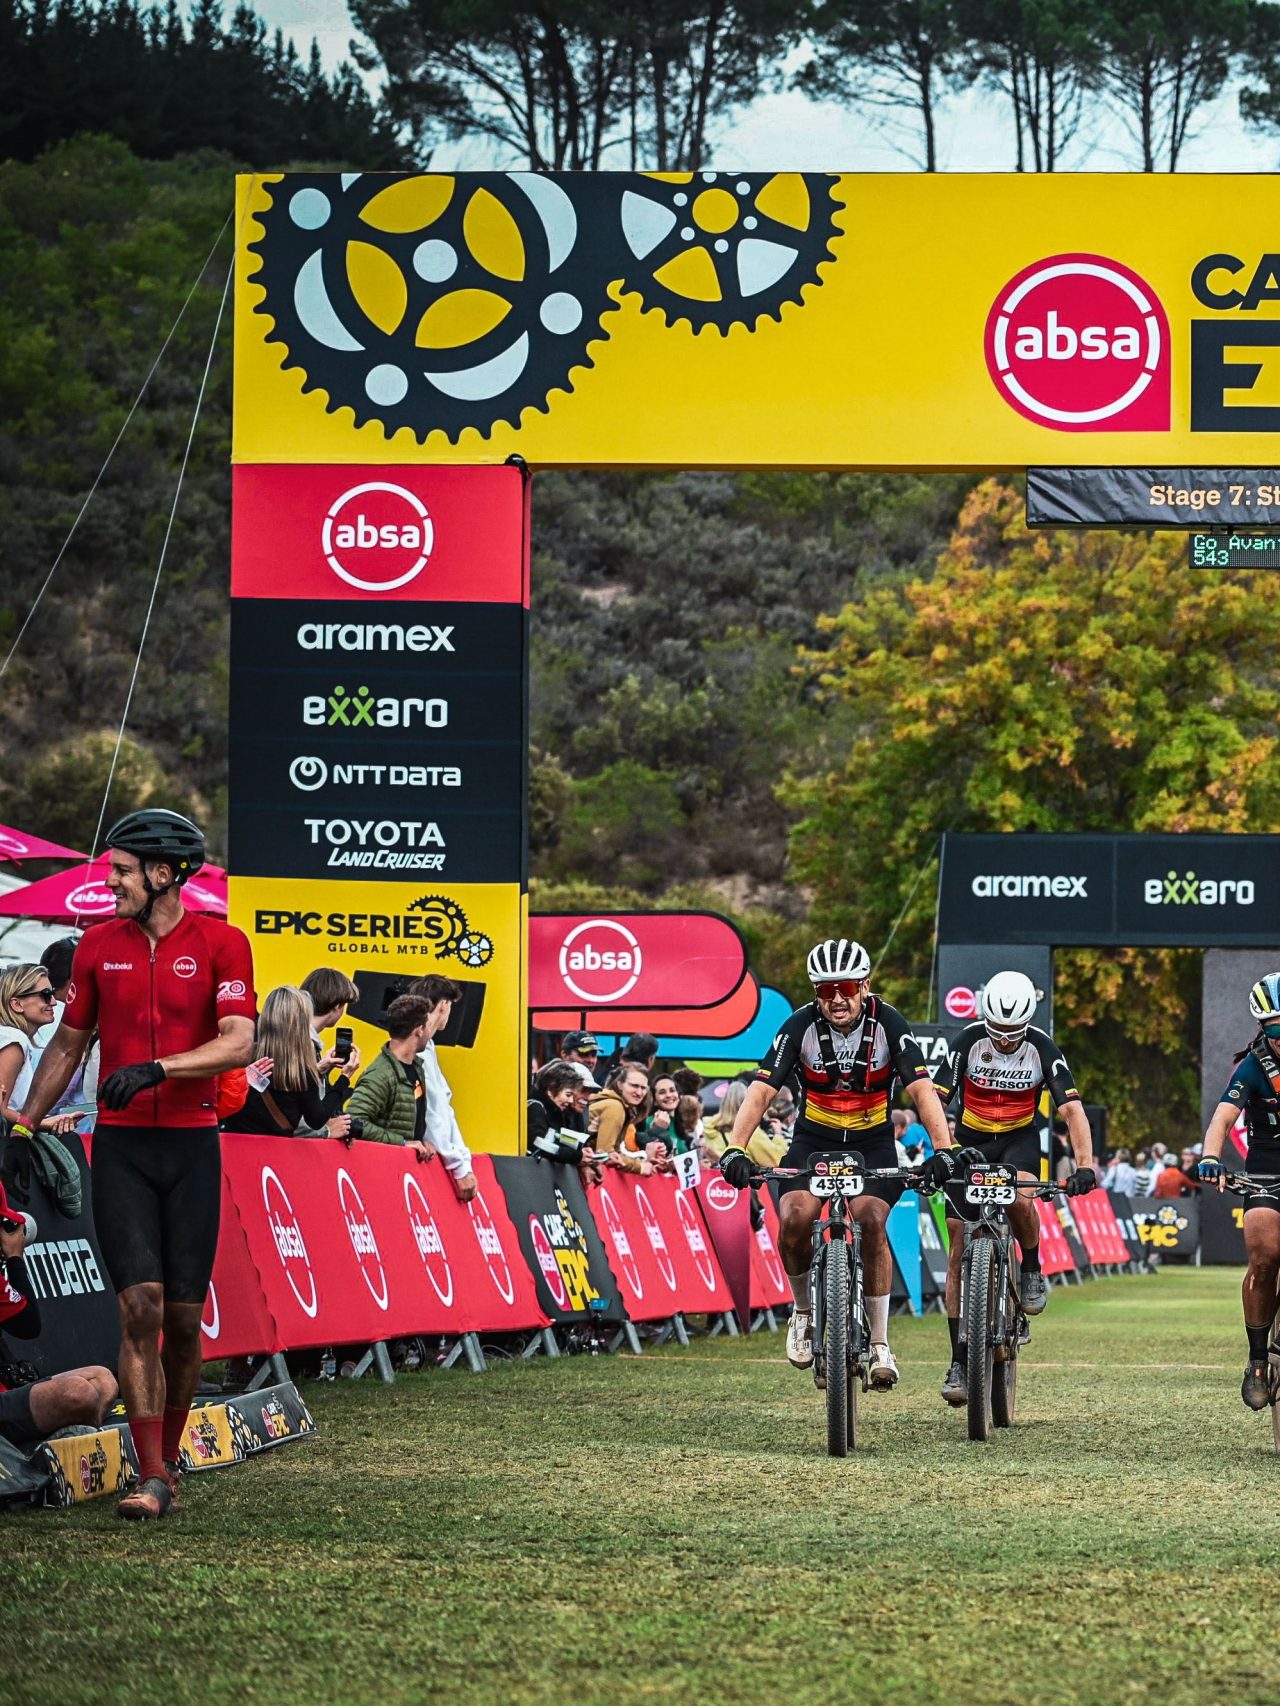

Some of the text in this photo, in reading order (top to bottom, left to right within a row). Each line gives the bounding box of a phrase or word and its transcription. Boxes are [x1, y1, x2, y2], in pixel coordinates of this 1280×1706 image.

[1015, 311, 1139, 360] absa
[1149, 485, 1221, 510] Stage
[1229, 486, 1251, 506] 7:
[335, 514, 420, 548] absa
[1194, 534, 1217, 550] Go
[1194, 551, 1229, 566] 543
[297, 623, 456, 652] aramex
[303, 687, 448, 727] exxaro
[304, 819, 446, 847] TOYOTA
[972, 875, 1088, 898] aramex
[1144, 871, 1255, 905] exxaro
[328, 943, 429, 955] GLOBAL MTB
[569, 943, 632, 970] absa
[972, 1066, 1033, 1079] SPECIALIZED
[987, 1080, 1033, 1089] TISSOT
[816, 1178, 858, 1191] 433-1
[984, 1177, 1007, 1186] EPIC
[710, 1187, 735, 1198] absa
[970, 1188, 1012, 1200] 433-2
